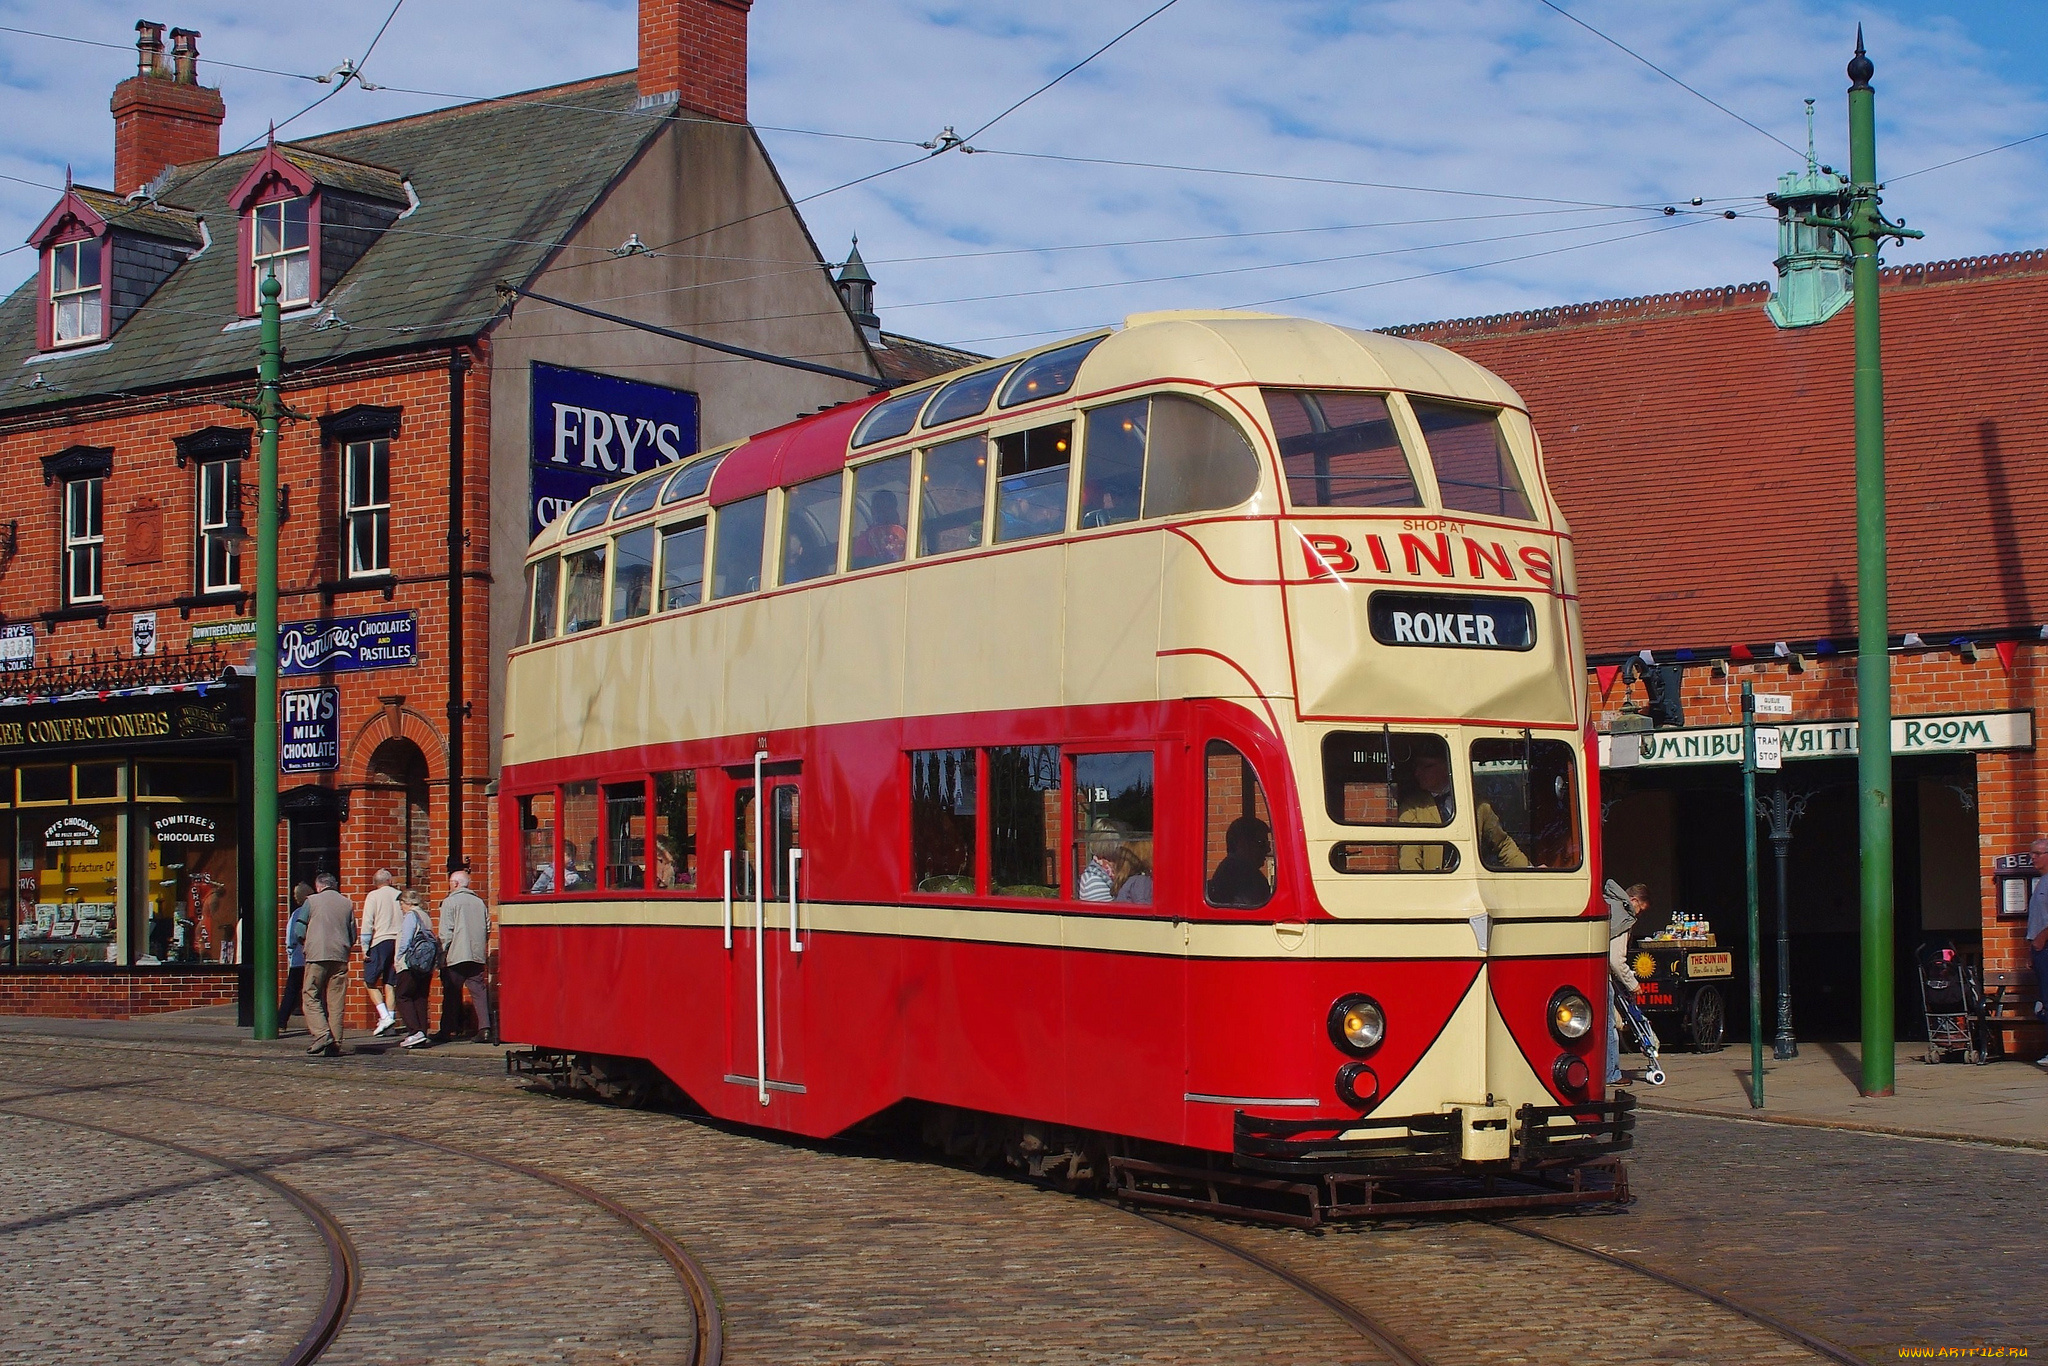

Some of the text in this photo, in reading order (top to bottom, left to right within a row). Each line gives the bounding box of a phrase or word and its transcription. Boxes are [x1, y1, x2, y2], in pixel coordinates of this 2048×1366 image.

[551, 402, 681, 475] FRY'S
[1403, 520, 1466, 534] SHOP AT
[1300, 532, 1555, 590] BINNS
[192, 623, 228, 639] ROWNTREE'S
[359, 619, 411, 637] CHOCOLATES
[1392, 611, 1498, 645] ROKER
[280, 626, 360, 668] Rowntree's
[377, 636, 391, 644] AND
[360, 644, 411, 662] PASTILLES
[285, 690, 335, 723] FRY'S
[27, 712, 170, 743] CONFECTIONERS
[293, 724, 326, 740] MILK
[1640, 733, 1741, 760] OMNIBU
[1905, 720, 1992, 746] ROOM
[1757, 736, 1779, 746] TRAM
[283, 741, 336, 760] CHOCOLATE
[1759, 752, 1778, 761] STOP
[44, 820, 63, 839] FRY'S
[64, 817, 101, 838] CHOCOLATE
[155, 815, 216, 830] ROWNTREE'S
[157, 832, 215, 842] CHOCOLATES
[105, 861, 115, 871] Of
[1691, 954, 1728, 965] THE SUN INN
[1641, 983, 1659, 993] HE
[1650, 995, 1673, 1005] INN
